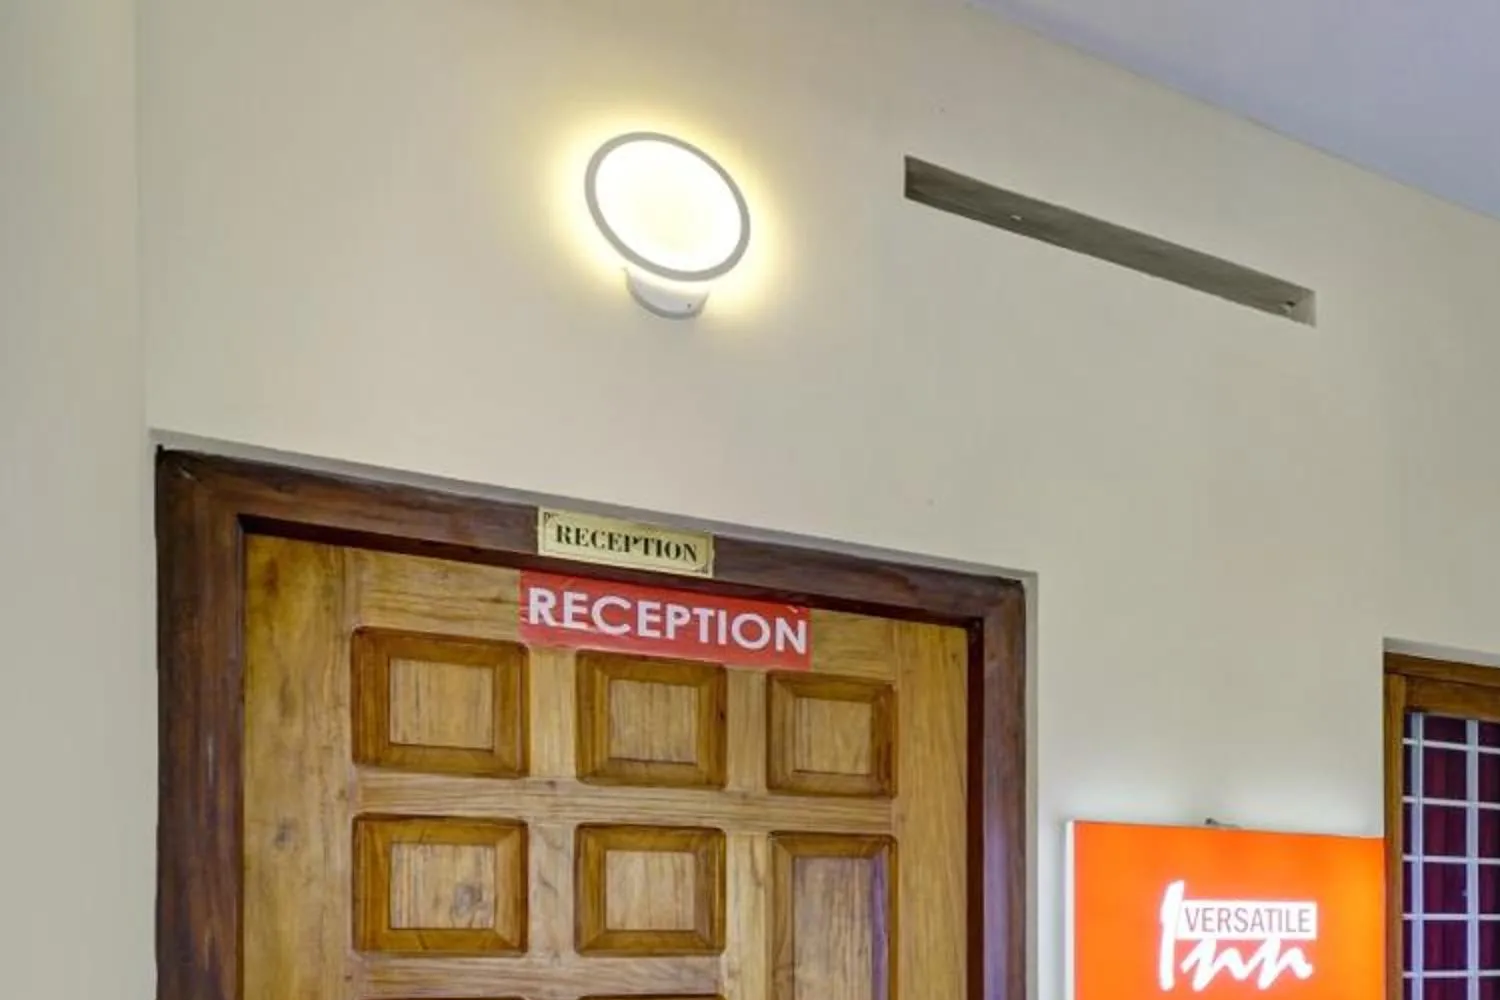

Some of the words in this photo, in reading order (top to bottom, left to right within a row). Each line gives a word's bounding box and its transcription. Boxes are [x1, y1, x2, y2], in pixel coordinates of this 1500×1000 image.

[556, 525, 698, 561] RECEPTION
[528, 587, 807, 654] RECEPTION
[1185, 907, 1312, 933] VERSATILE
